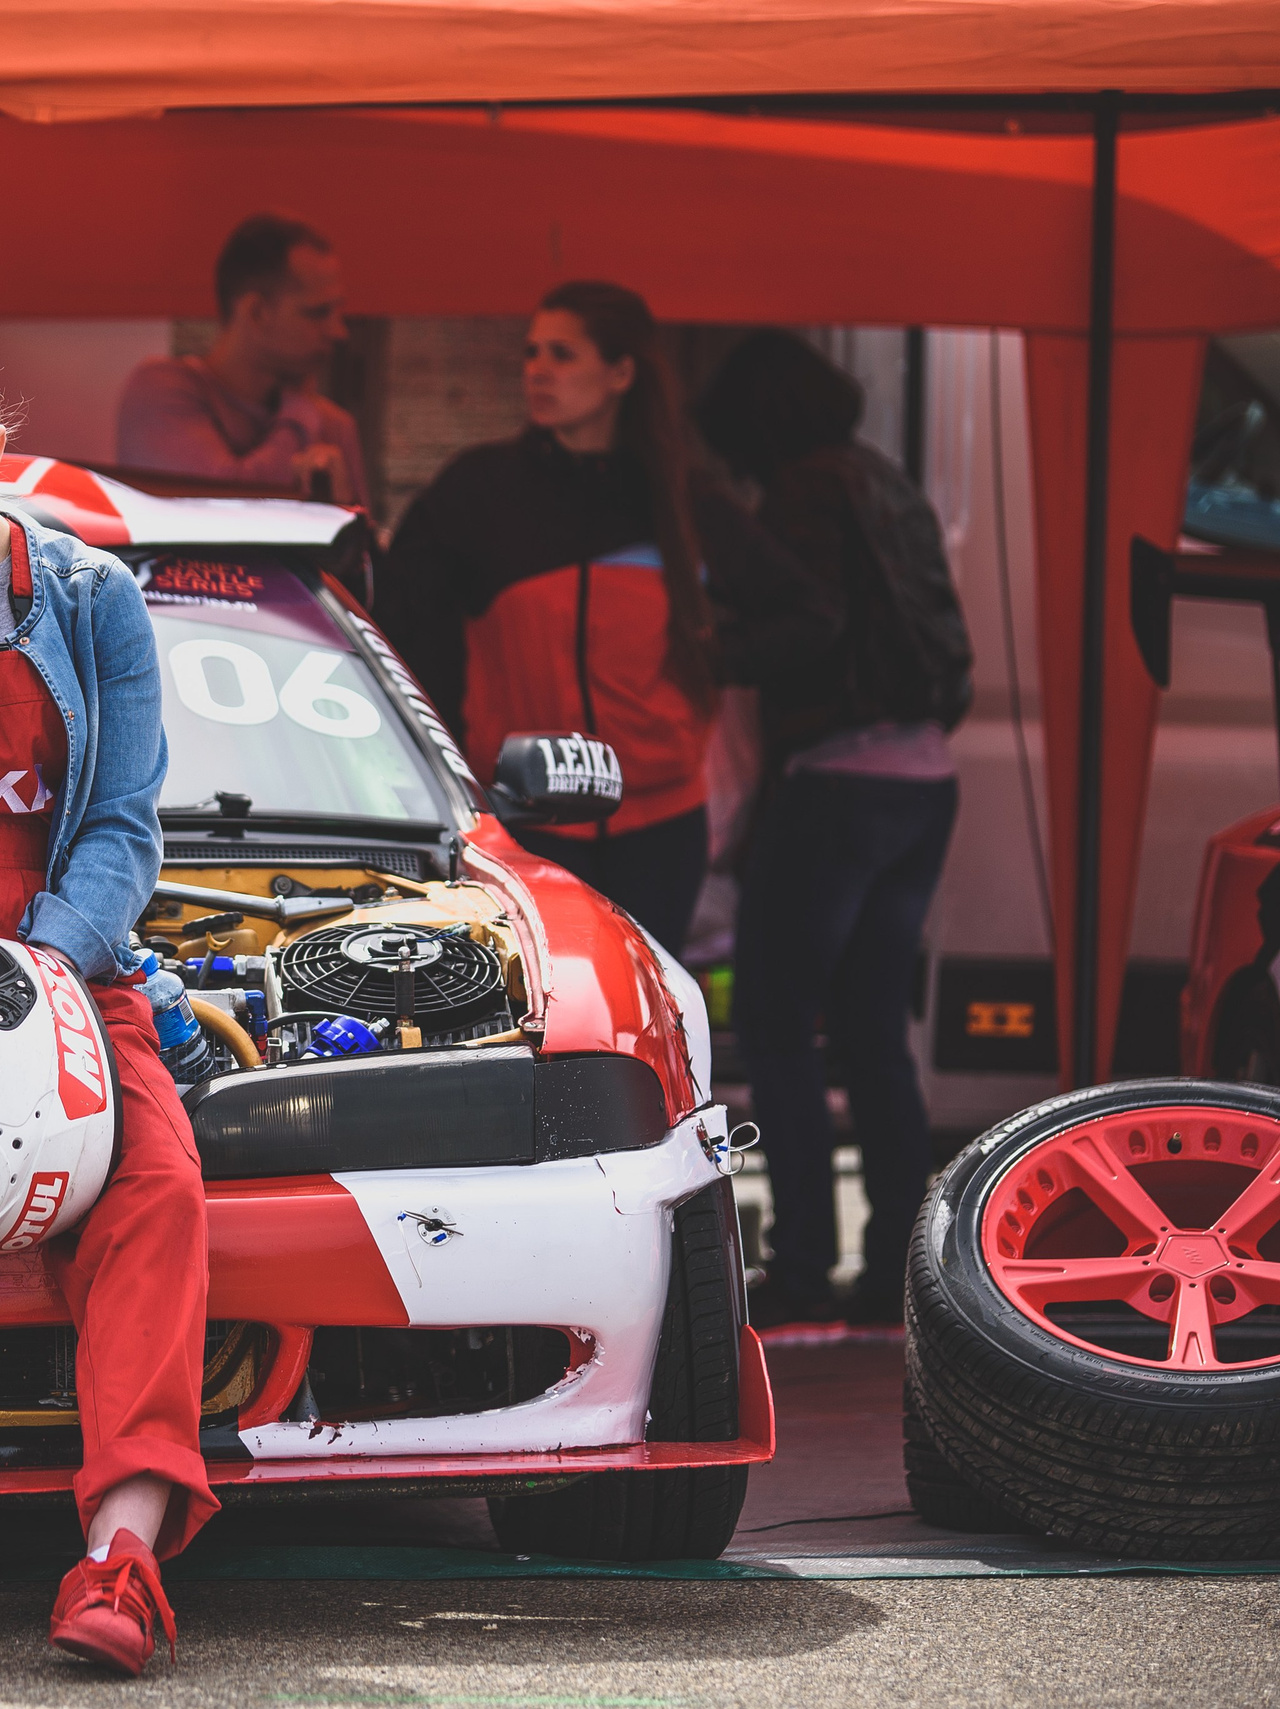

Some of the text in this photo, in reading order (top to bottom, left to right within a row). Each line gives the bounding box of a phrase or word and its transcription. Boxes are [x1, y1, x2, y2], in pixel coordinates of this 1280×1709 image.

[155, 574, 254, 598] SERIES
[168, 638, 382, 739] 06
[547, 775, 623, 800] DRIFT TEAM
[33, 950, 104, 1100] MOTU
[1, 1177, 63, 1251] OTUL
